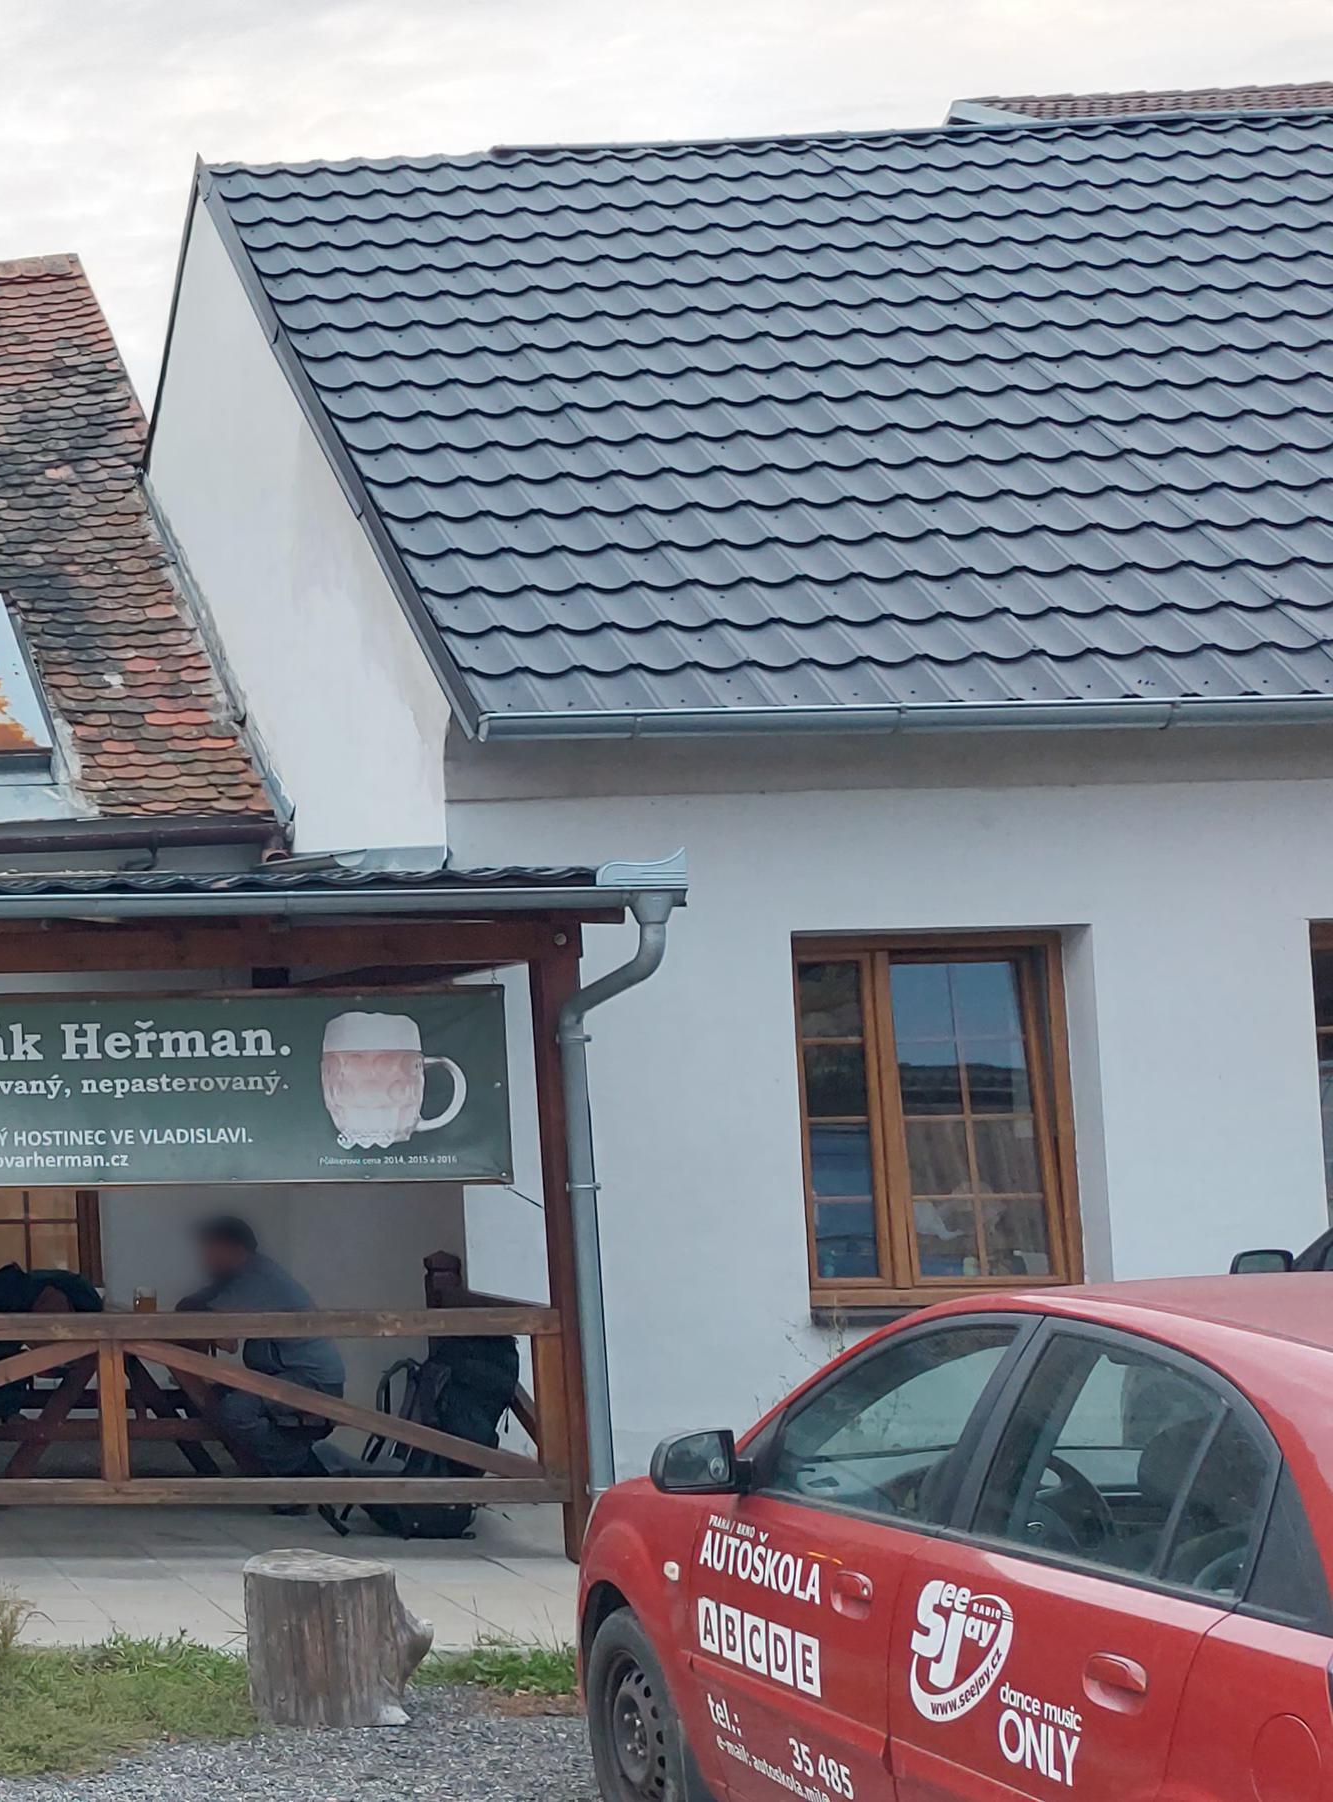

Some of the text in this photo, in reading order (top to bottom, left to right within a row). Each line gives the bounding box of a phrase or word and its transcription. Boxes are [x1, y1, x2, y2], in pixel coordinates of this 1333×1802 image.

[60, 1020, 291, 1060] Heřman.
[80, 1070, 290, 1098] nepasterovaný.
[13, 1129, 107, 1147] HOSTINEC
[110, 1129, 135, 1145] VE
[139, 1127, 254, 1145] VLADISLAVI.
[408, 1155, 429, 1165] 2015
[699, 1530, 821, 1605] AUTOŠKOLA
[972, 1602, 1002, 1619] RADIO
[929, 1647, 1003, 1716] www.seejay.cz
[999, 1682, 1082, 1733] dance music
[716, 1734, 752, 1768] e-mail:
[998, 1708, 1081, 1787] ONLY
[788, 1737, 854, 1801] 35 485
